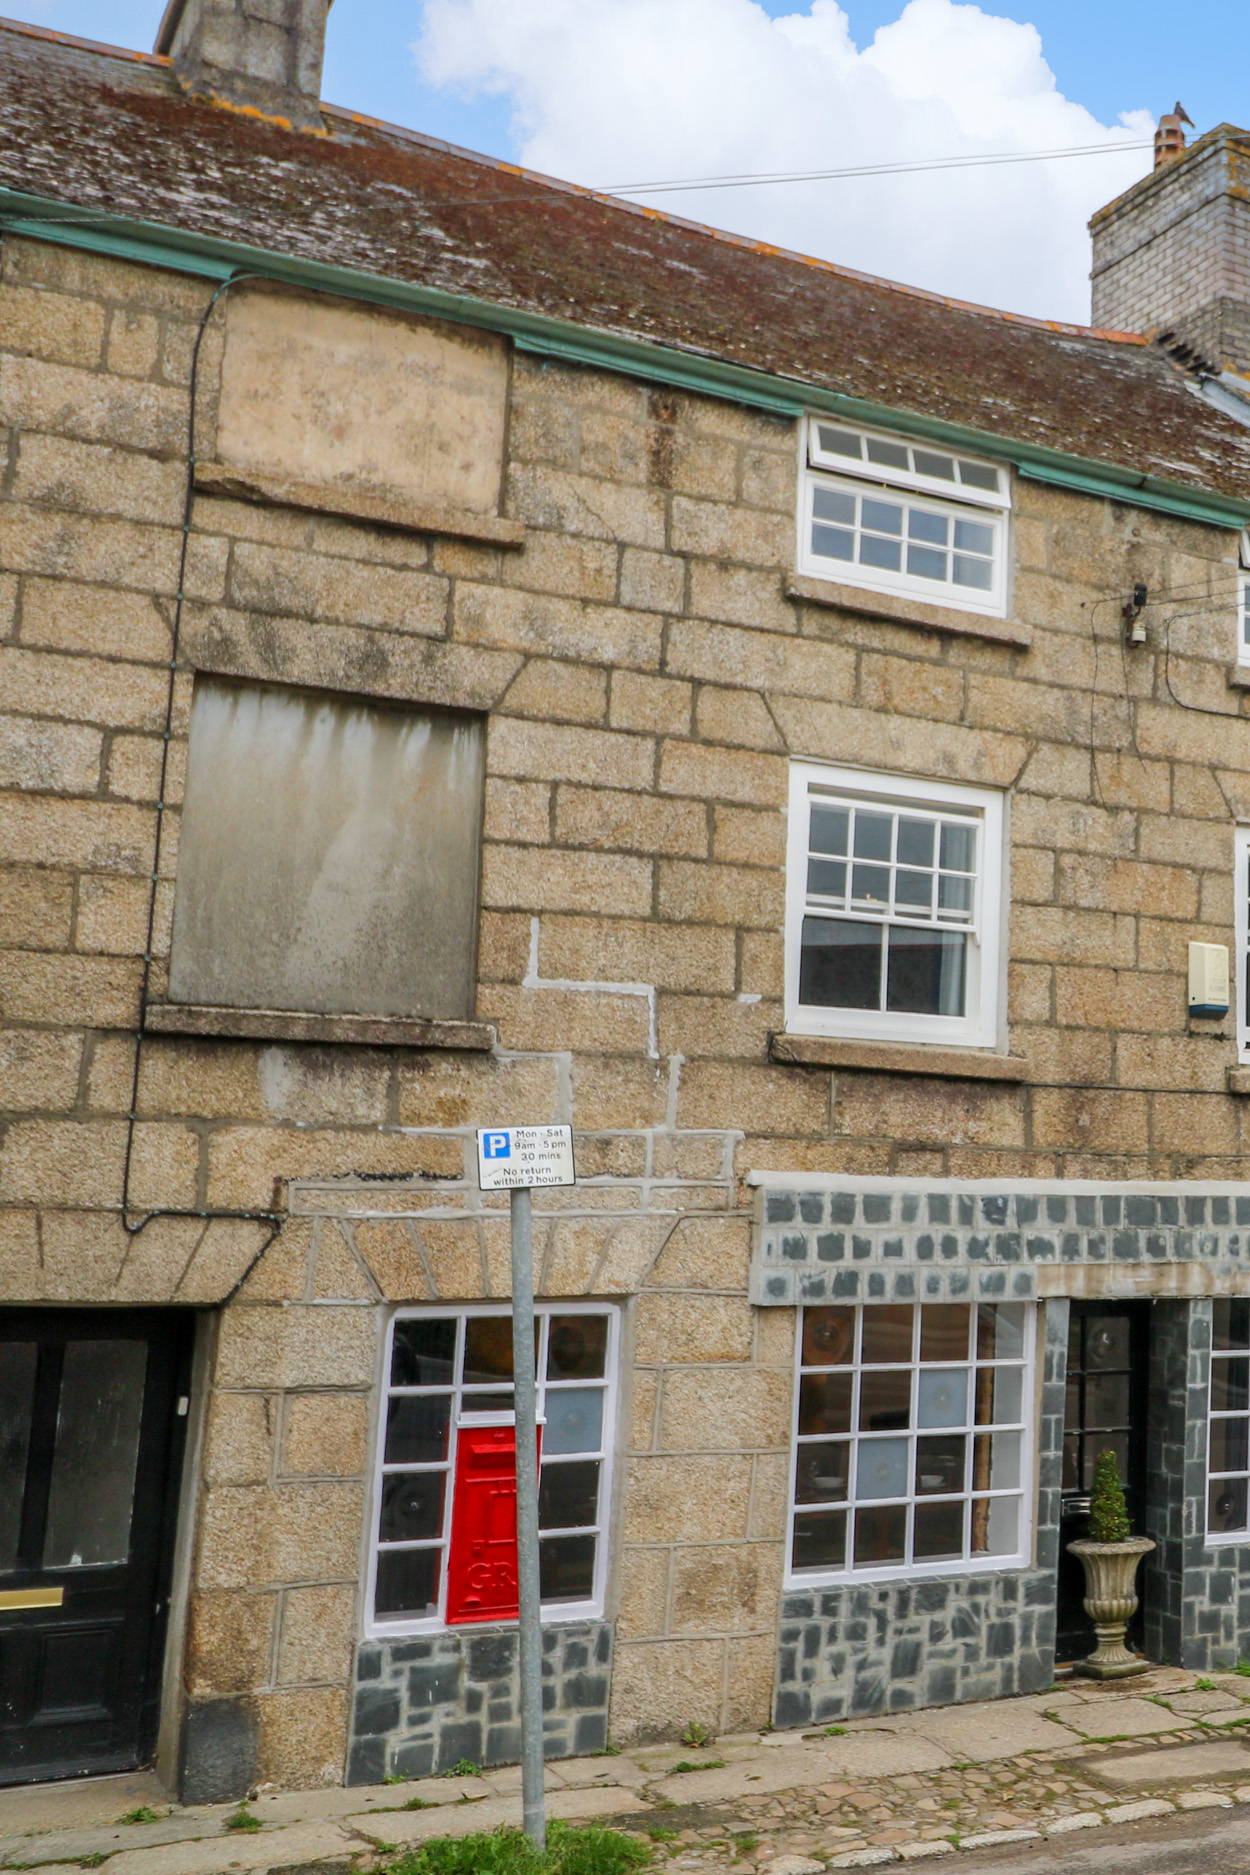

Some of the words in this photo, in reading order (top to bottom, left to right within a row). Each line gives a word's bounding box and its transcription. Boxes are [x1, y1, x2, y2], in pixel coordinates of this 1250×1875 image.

[516, 1130, 537, 1139] Mon
[547, 1128, 564, 1137] Sat
[489, 1135, 507, 1157] P
[514, 1141, 536, 1150] 9am
[521, 1153, 535, 1161] 30
[538, 1151, 562, 1160] mins
[503, 1167, 518, 1176] No
[520, 1167, 552, 1175] return
[493, 1176, 524, 1187] within
[527, 1176, 534, 1184] 2
[536, 1175, 563, 1184] hours
